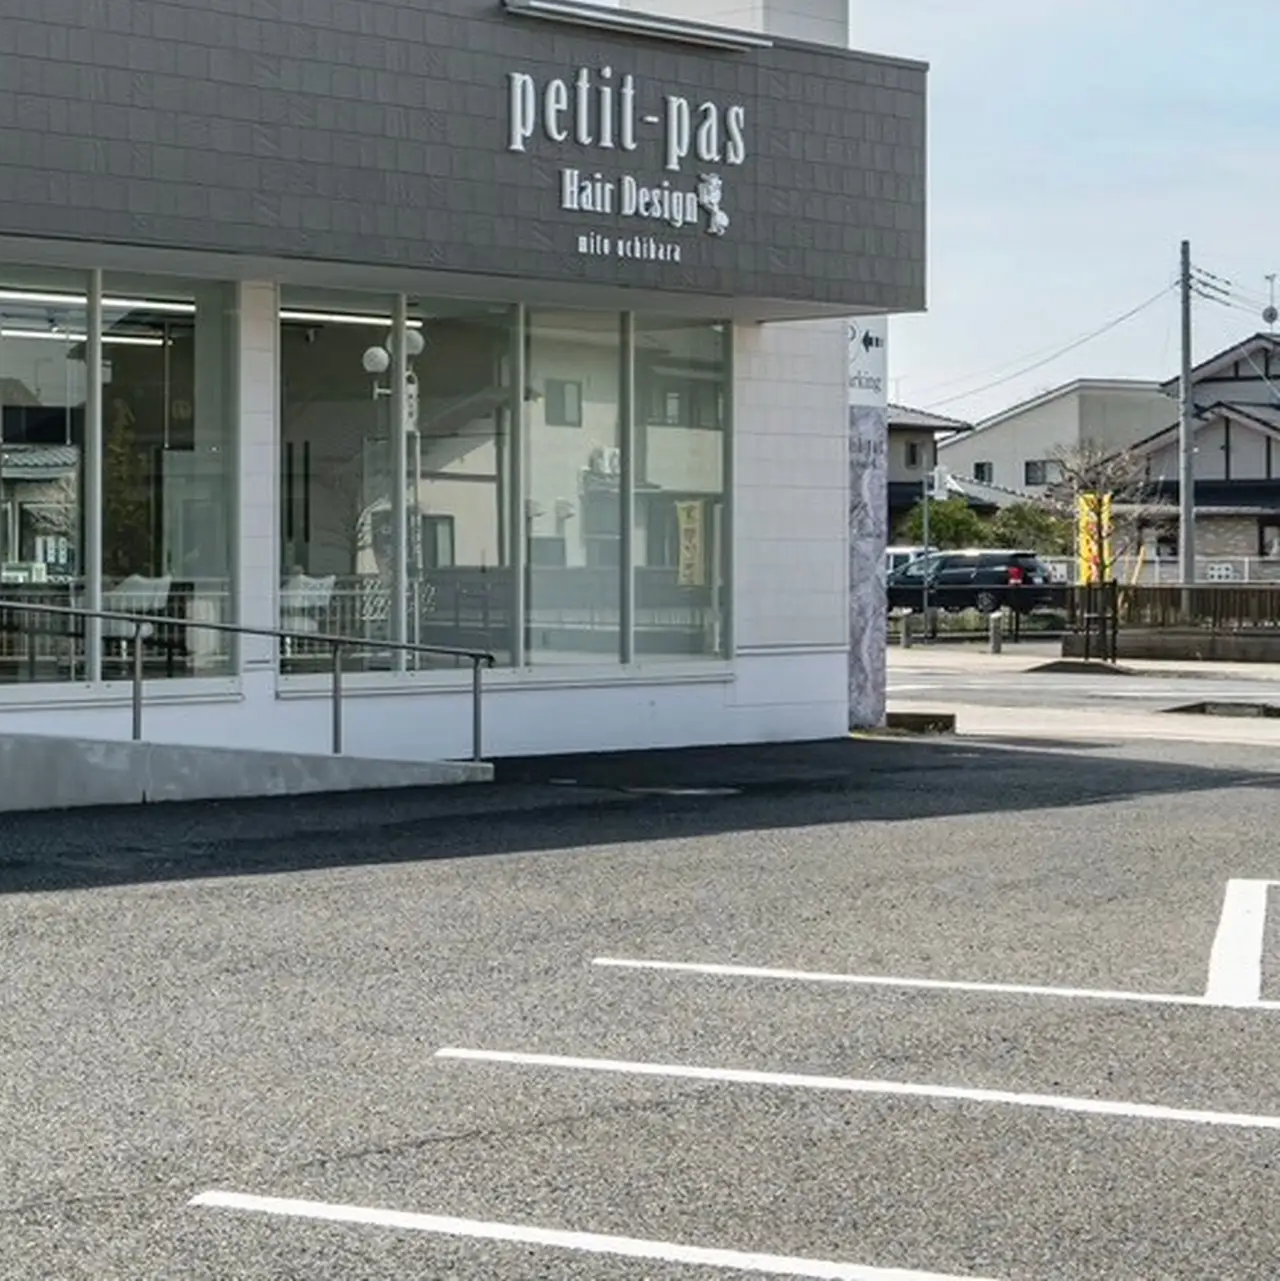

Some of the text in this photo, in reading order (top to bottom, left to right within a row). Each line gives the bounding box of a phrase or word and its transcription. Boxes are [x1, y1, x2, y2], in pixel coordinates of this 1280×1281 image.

[507, 65, 746, 171] petit-pas
[560, 168, 699, 228] Hair Design
[577, 231, 682, 262] mito uchihara
